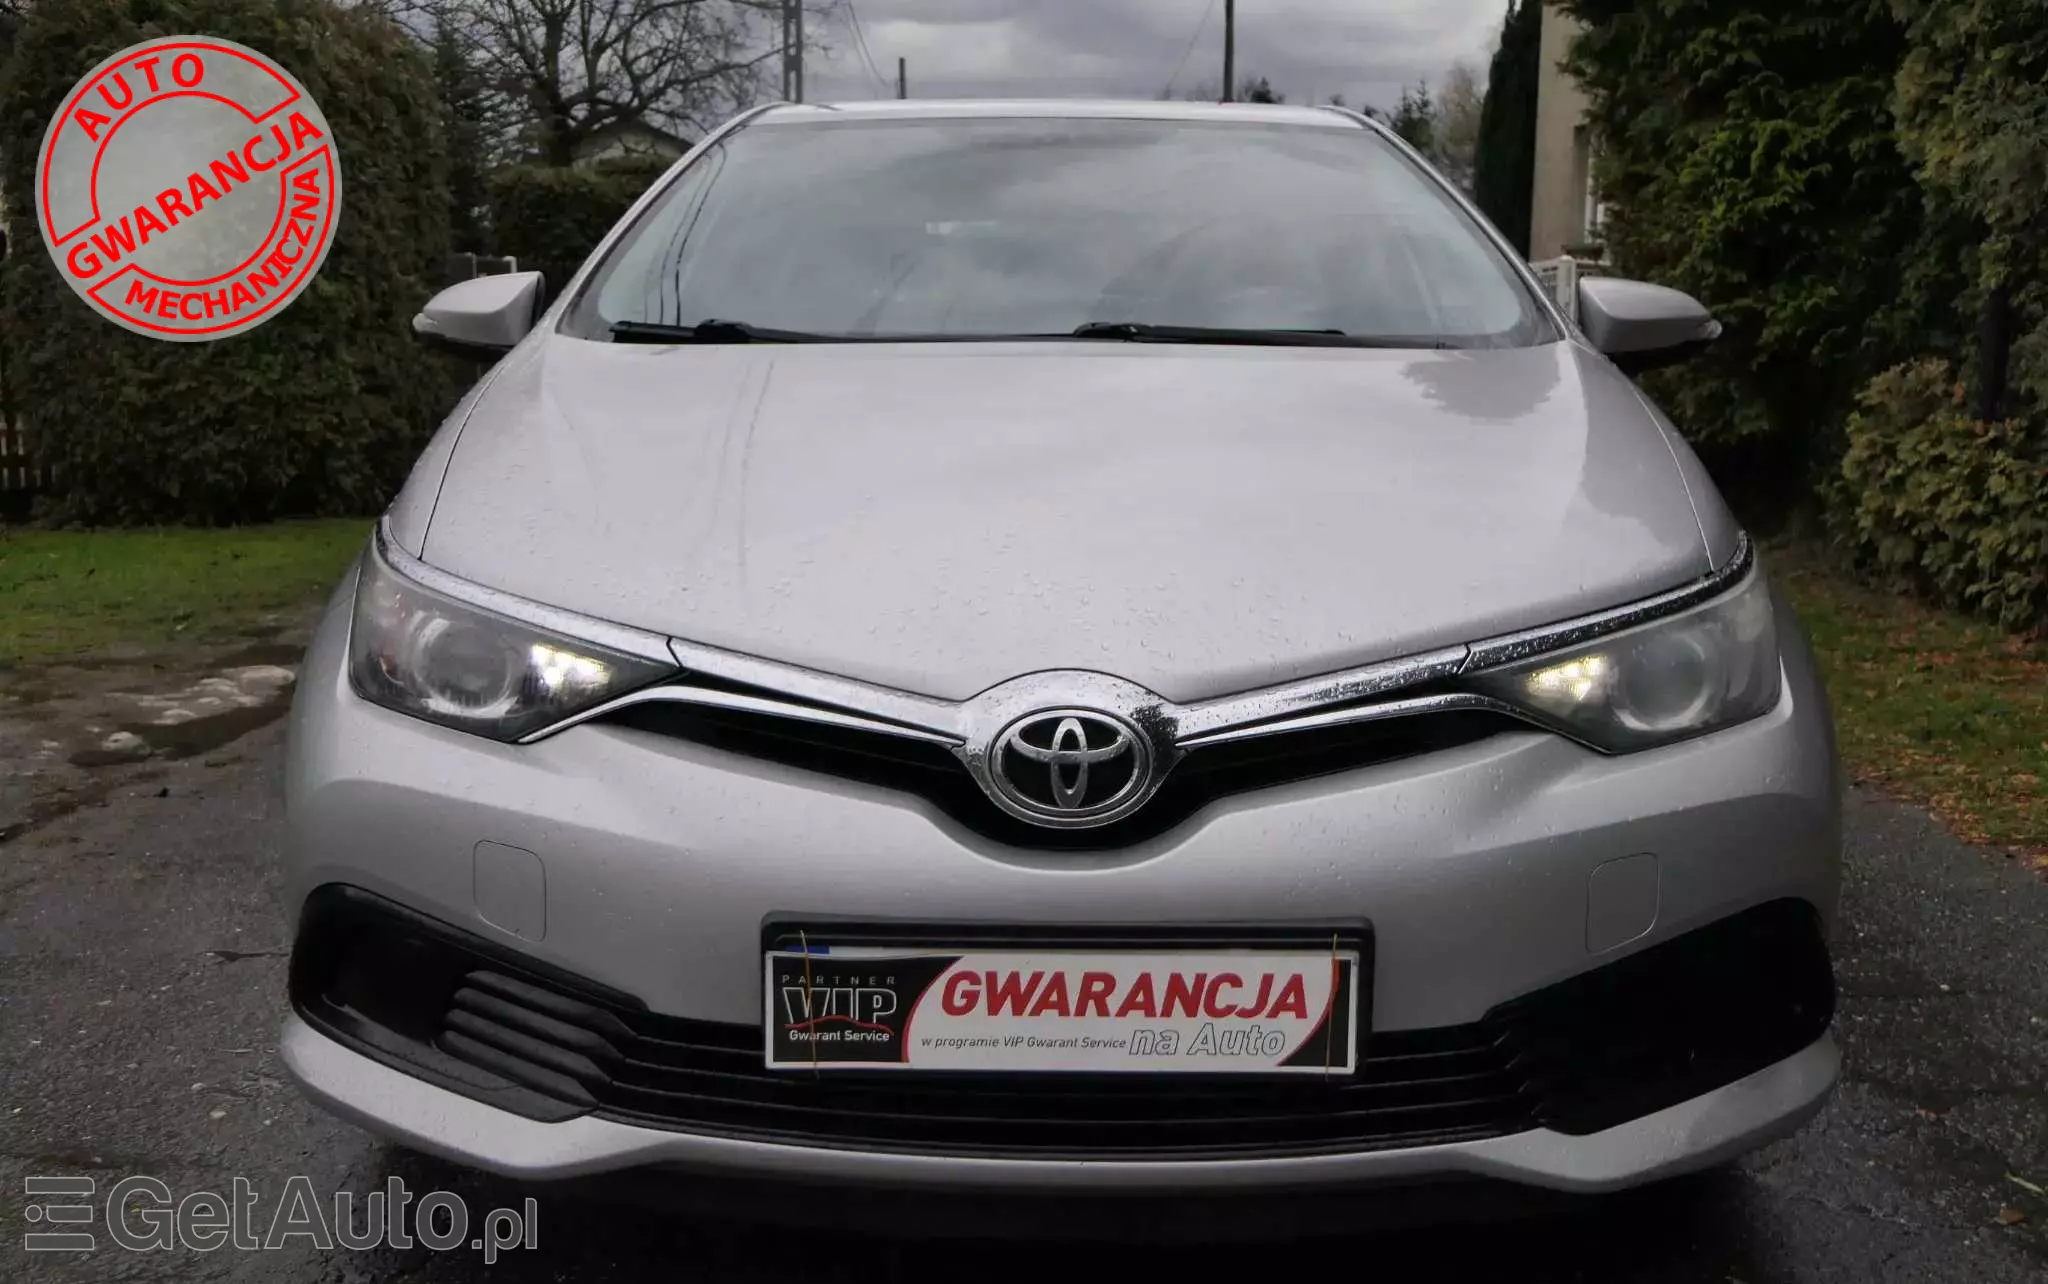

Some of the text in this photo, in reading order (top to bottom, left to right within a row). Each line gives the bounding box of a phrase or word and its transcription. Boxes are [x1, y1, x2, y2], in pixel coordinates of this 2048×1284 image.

[782, 974, 896, 985] PARTNER
[783, 988, 897, 1024] VIP
[941, 970, 1308, 1019] GWARANCJA
[789, 1029, 890, 1042] Gwarant Service
[921, 1035, 1127, 1049] w programie VIP Gwarant Service
[1129, 1022, 1286, 1056] na Auto
